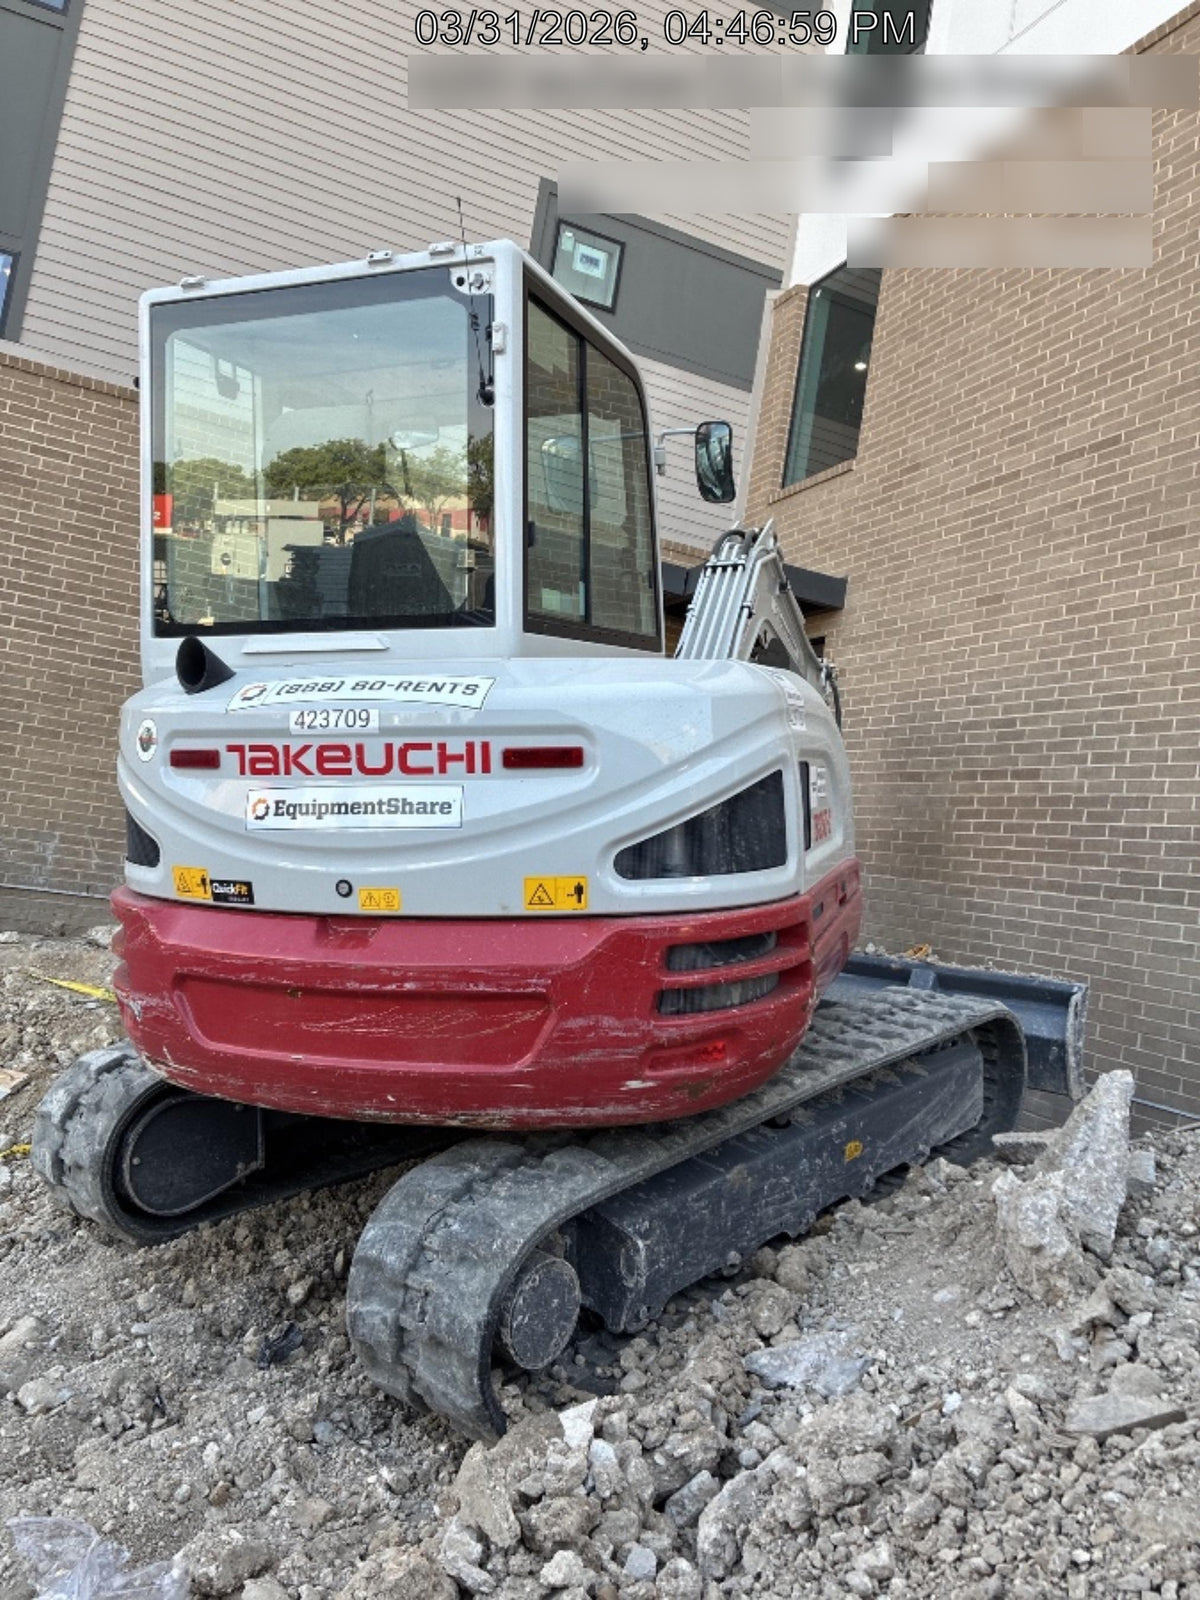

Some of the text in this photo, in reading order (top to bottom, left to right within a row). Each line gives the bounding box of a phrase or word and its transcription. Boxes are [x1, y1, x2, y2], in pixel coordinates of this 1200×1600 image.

[275, 680, 481, 697] (888) 80-RENTS
[294, 709, 371, 730] 423709
[226, 741, 492, 776] TAKEUCHI
[273, 797, 453, 821] EquipmentShare
